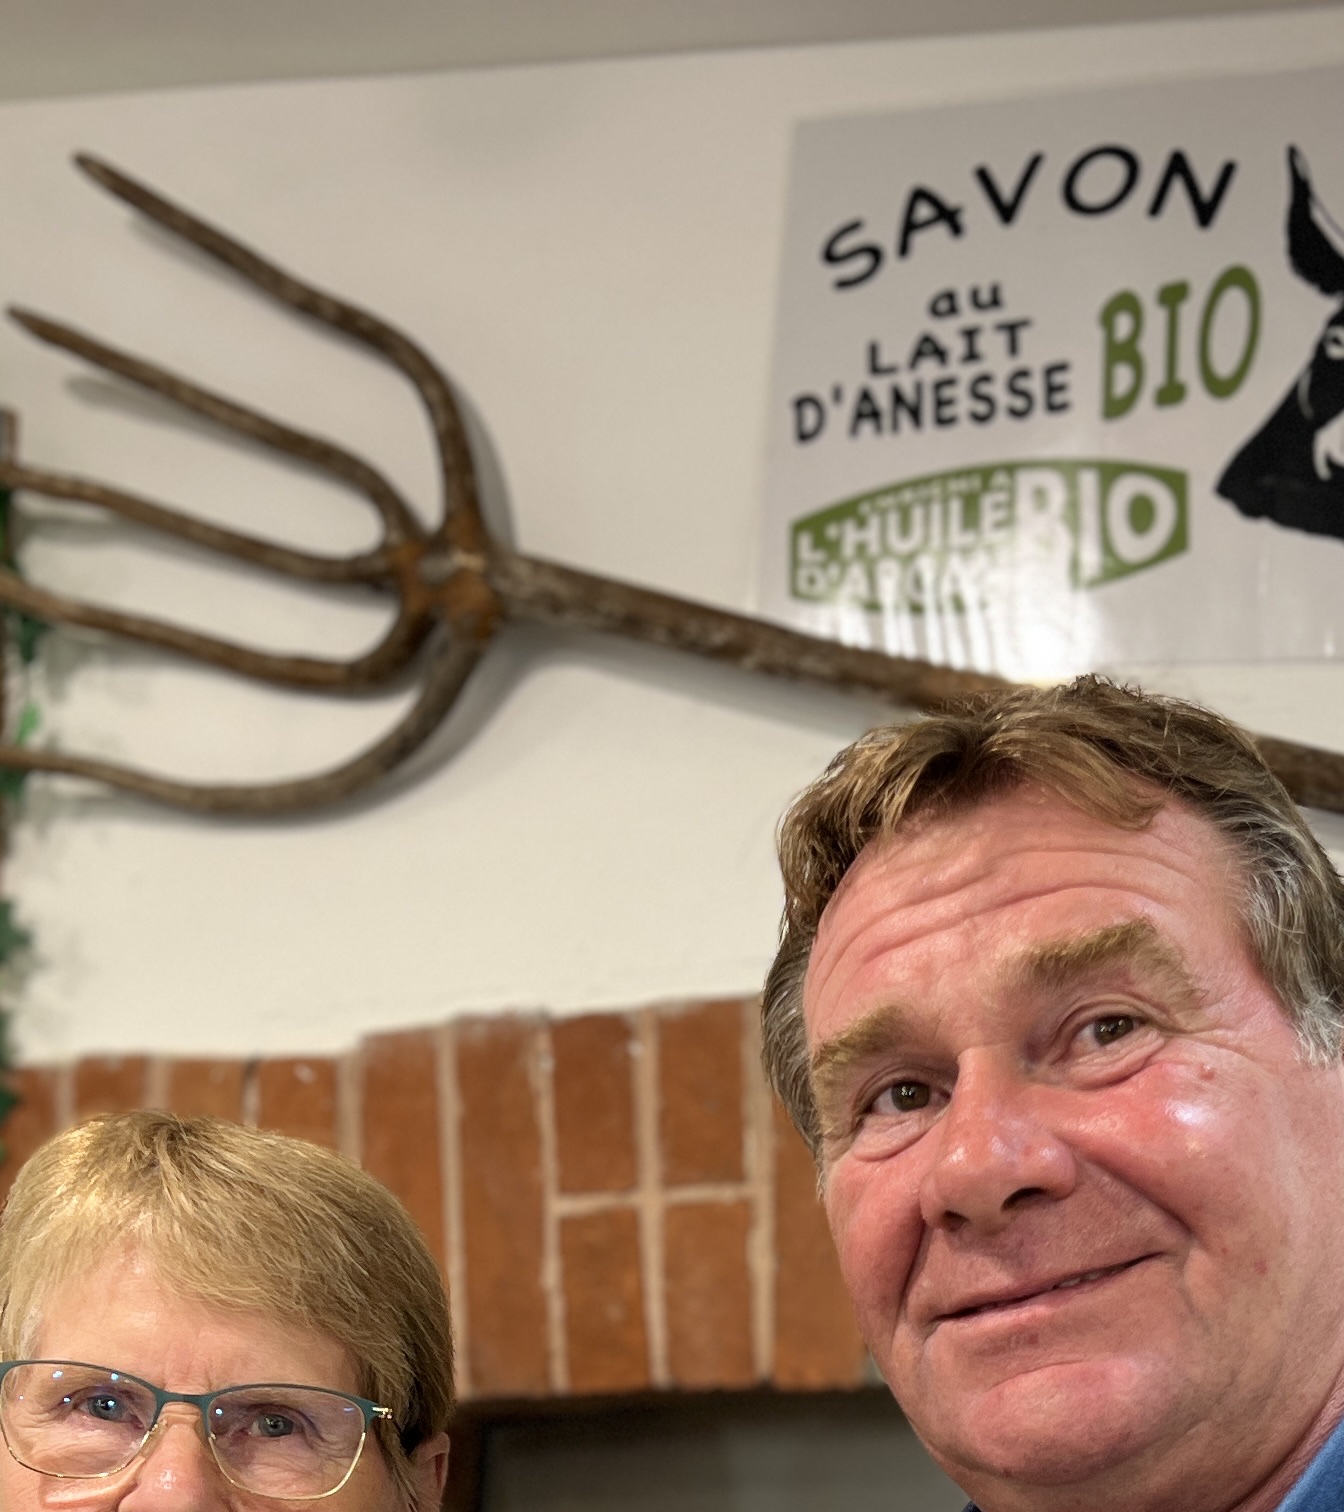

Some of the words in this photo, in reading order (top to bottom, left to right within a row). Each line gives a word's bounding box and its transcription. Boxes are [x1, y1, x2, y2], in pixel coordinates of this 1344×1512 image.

[821, 143, 1237, 290] SAVON
[928, 281, 1003, 318] au
[869, 318, 1032, 376] LAIT
[1099, 264, 1262, 421] BIO
[794, 362, 1071, 444] D'ANESSE
[797, 491, 1011, 565] L'HUILE
